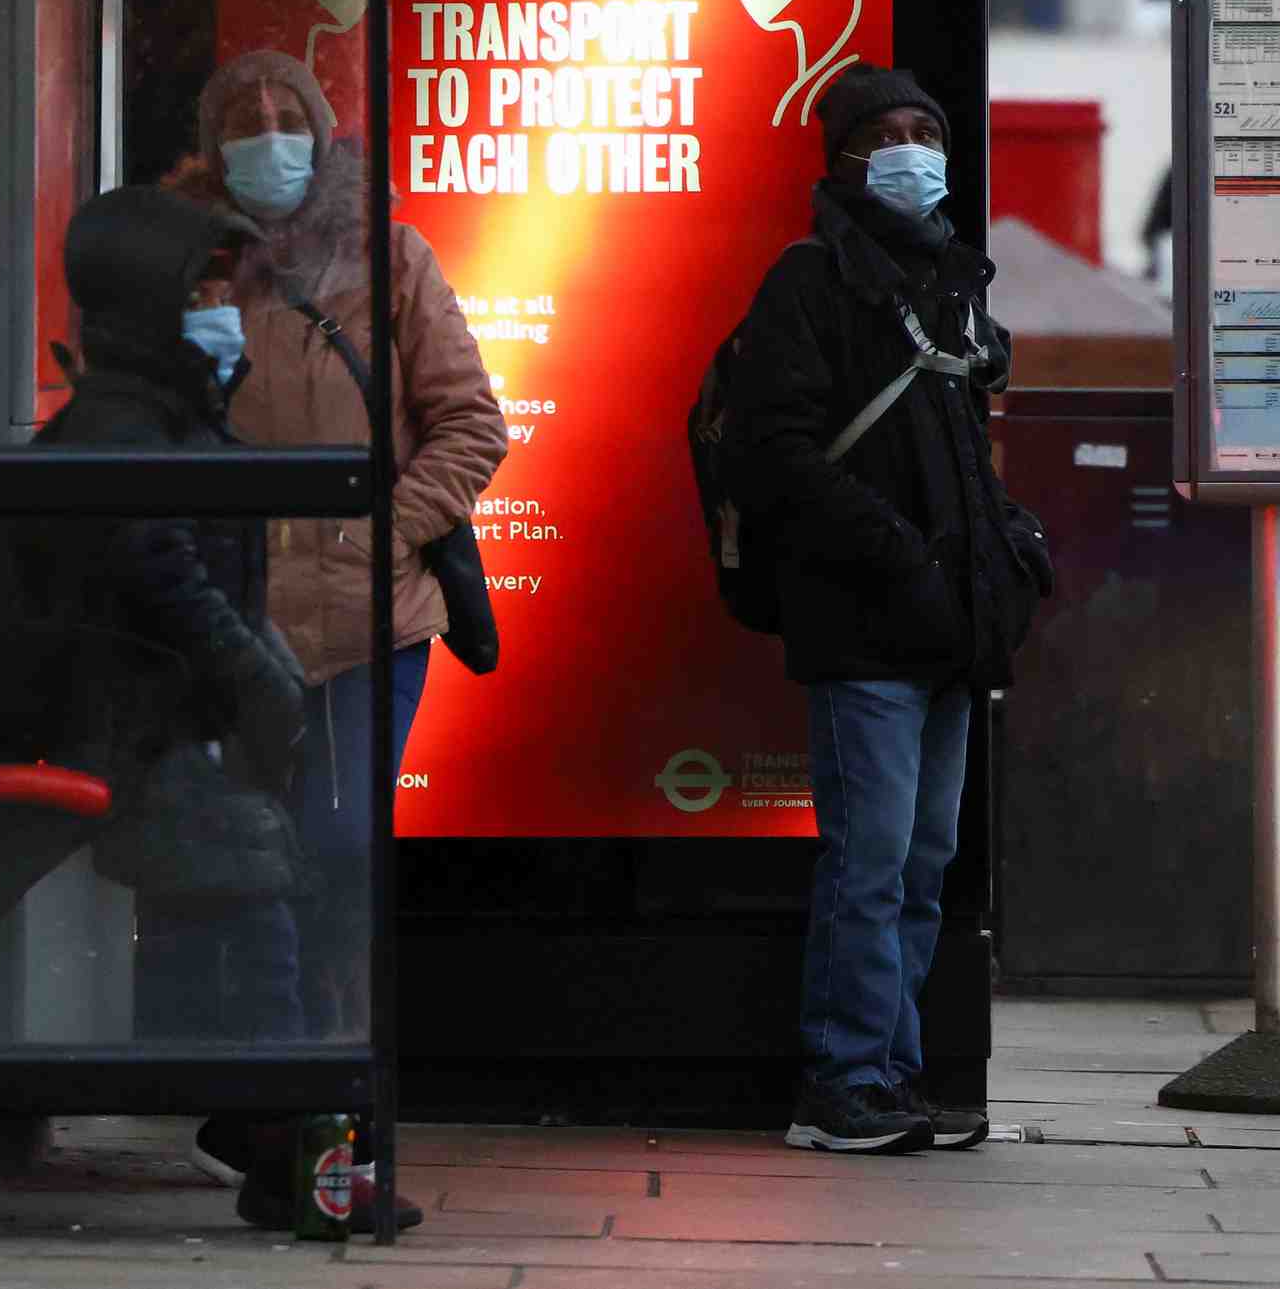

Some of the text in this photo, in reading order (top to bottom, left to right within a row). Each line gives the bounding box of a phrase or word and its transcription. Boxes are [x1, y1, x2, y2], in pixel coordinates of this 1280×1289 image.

[412, 2, 698, 61] TRANSPORT
[408, 67, 703, 127] TO PROTECT
[1214, 103, 1235, 115] 521
[410, 133, 701, 193] EACH OTHER
[524, 296, 555, 315] all
[1214, 290, 1236, 302] N21
[468, 319, 550, 344] velling
[497, 395, 557, 415] hose
[507, 424, 535, 444] ey
[474, 497, 546, 518] ation,
[473, 521, 564, 540] art Plan.
[396, 773, 429, 789] ON
